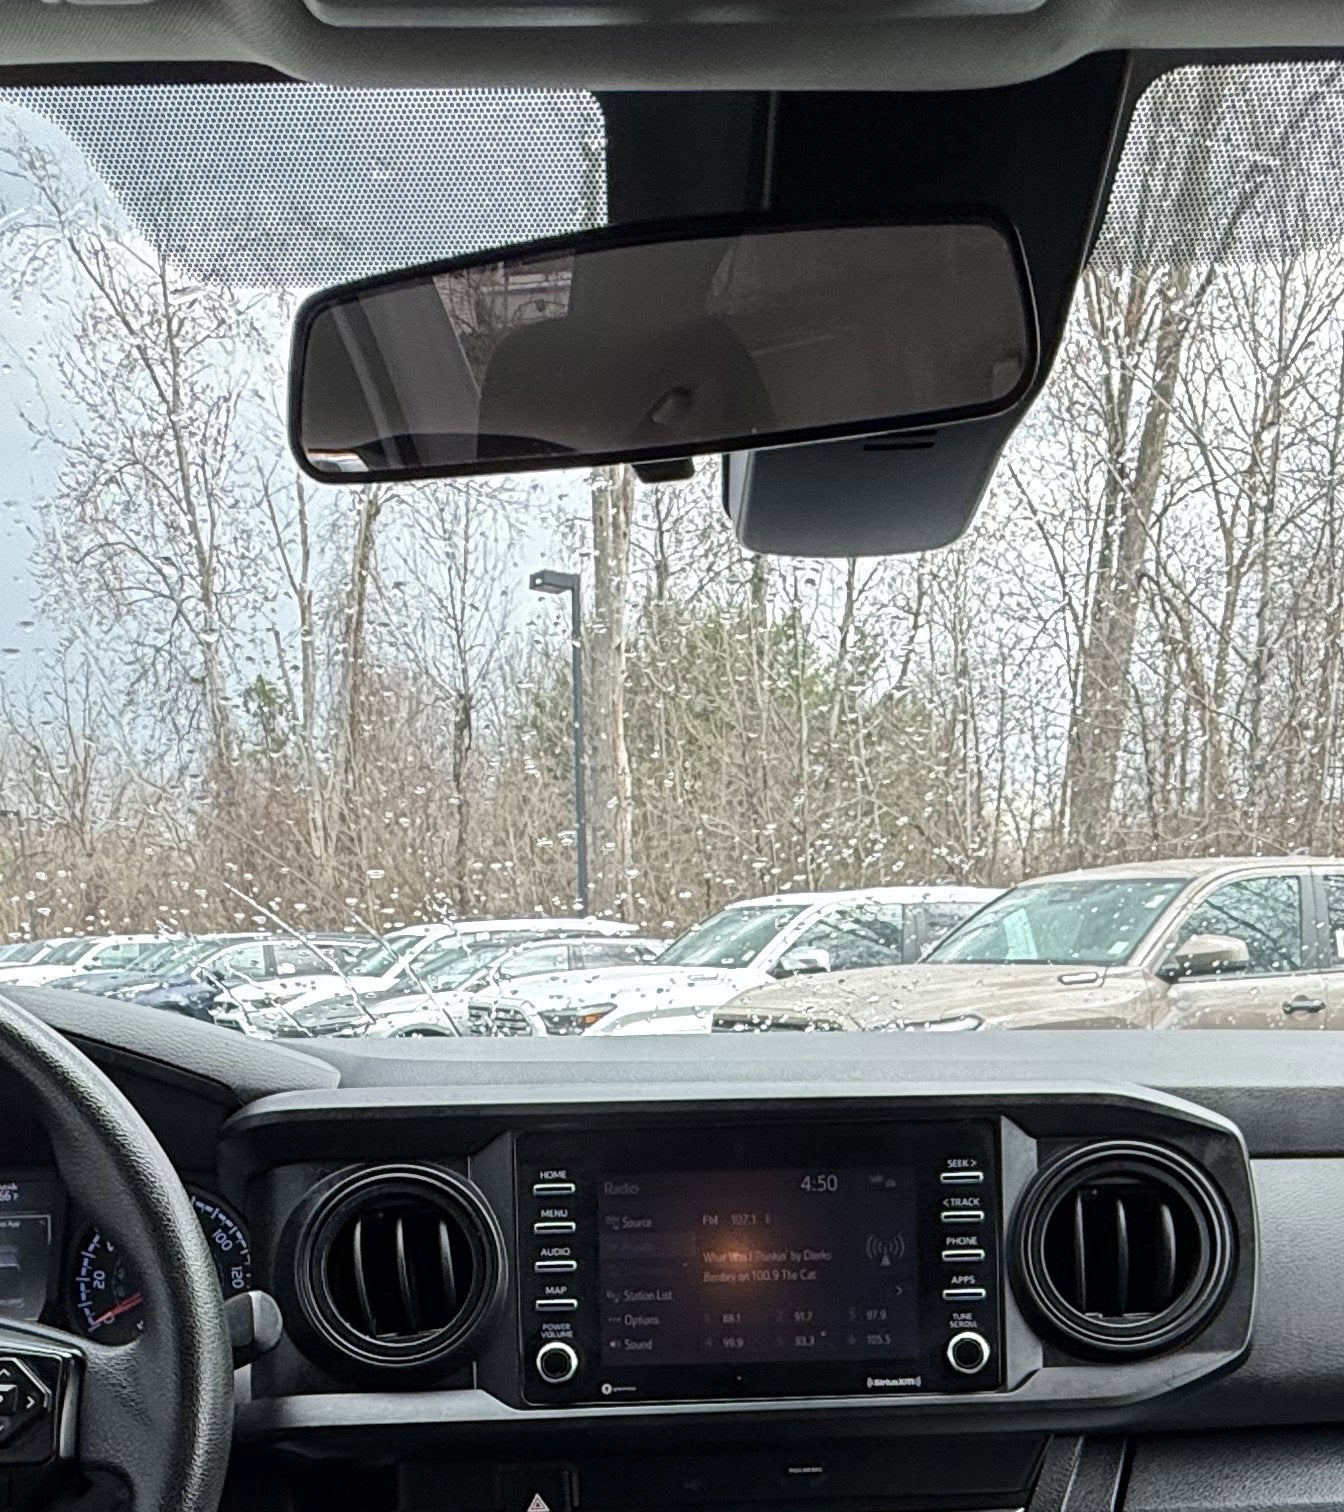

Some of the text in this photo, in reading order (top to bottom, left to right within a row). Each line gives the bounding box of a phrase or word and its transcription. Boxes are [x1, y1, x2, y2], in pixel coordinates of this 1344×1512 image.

[947, 1159, 969, 1168] SEEK
[539, 1170, 567, 1179] HOME
[605, 1182, 639, 1195] Radio
[801, 1174, 838, 1192] 4:50
[951, 1198, 980, 1207] TRACK
[541, 1209, 568, 1218] MENU
[622, 1216, 652, 1228] Source
[702, 1215, 718, 1226] FM
[212, 1228, 233, 1251] 100
[946, 1236, 977, 1246] PHONE
[540, 1247, 571, 1256] AUDIO
[93, 1270, 105, 1290] 20
[230, 1265, 244, 1289] 120
[752, 1270, 779, 1281] 100.9
[781, 1269, 797, 1280] The
[951, 1275, 976, 1284] APPS
[545, 1286, 567, 1295] MAP
[624, 1290, 673, 1301] Station List
[624, 1314, 660, 1328] Options
[542, 1323, 571, 1331] POWER
[540, 1331, 574, 1339] VOLUME
[624, 1339, 653, 1351] Sound
